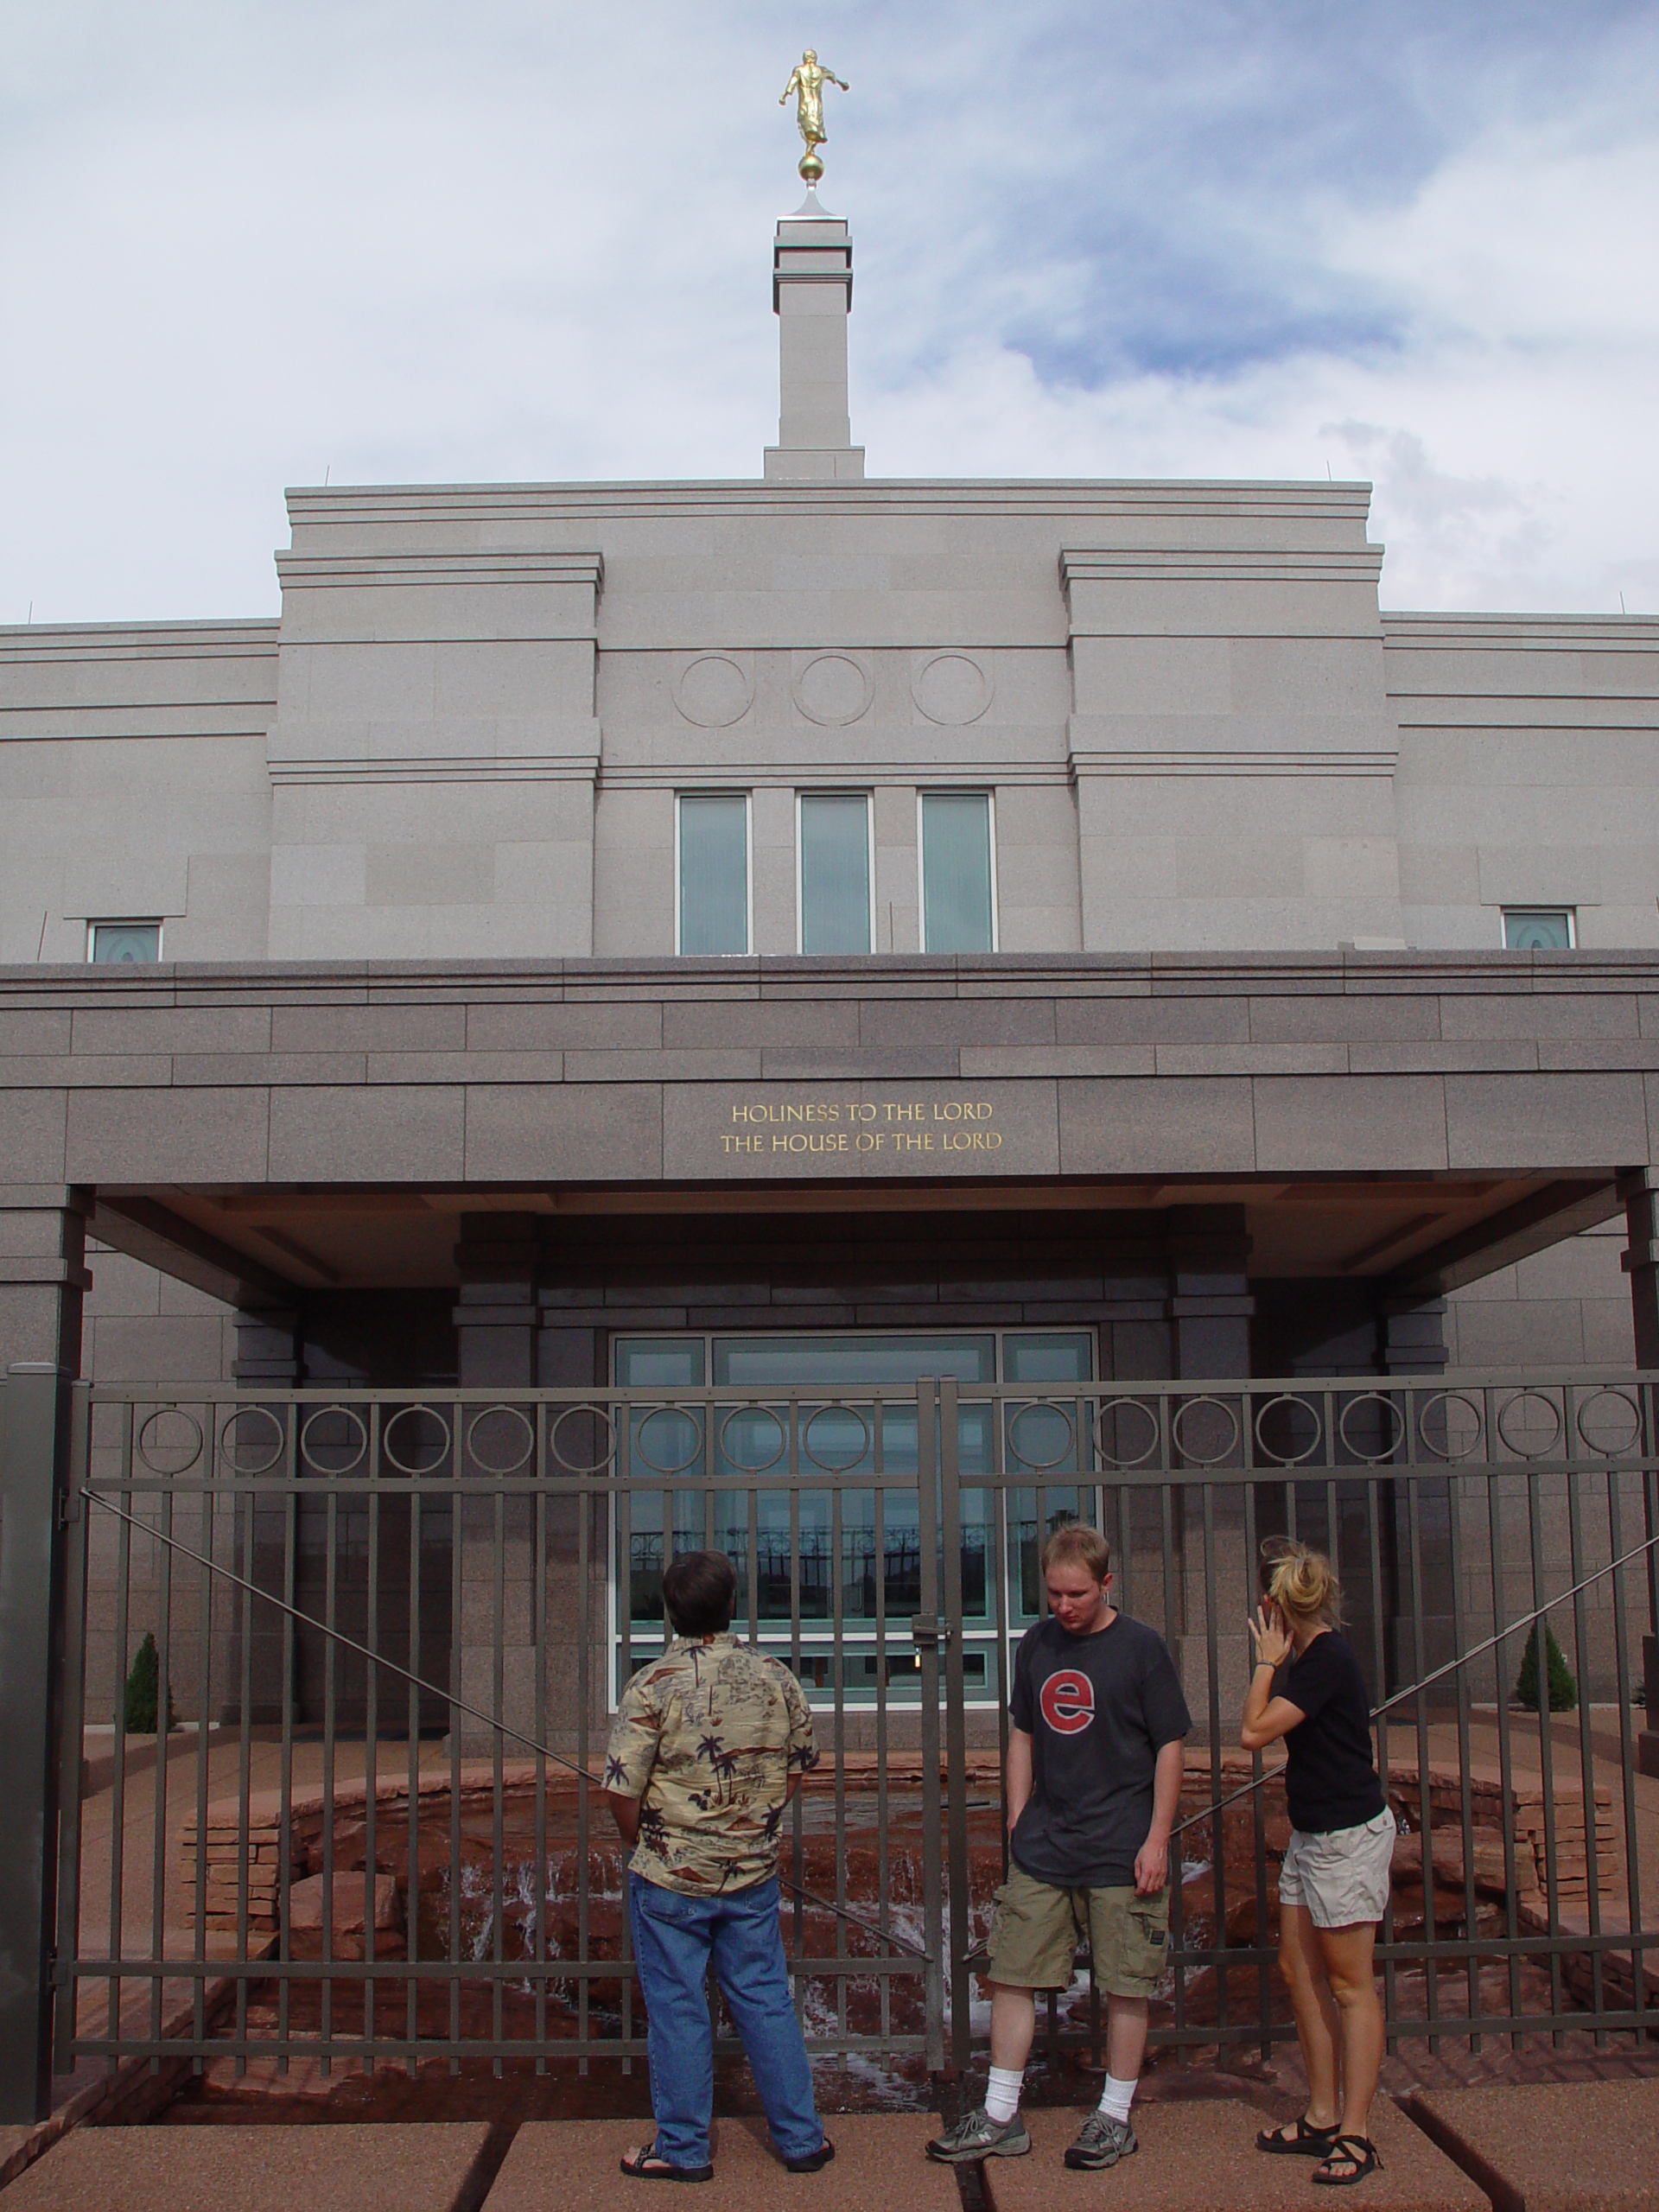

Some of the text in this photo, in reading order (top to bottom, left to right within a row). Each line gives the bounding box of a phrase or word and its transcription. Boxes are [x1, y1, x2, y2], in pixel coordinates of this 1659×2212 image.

[732, 1103, 993, 1122] HOLINESS TO THE LORD
[721, 1132, 1002, 1152] THE HOUSE OF THE LORD
[1039, 1669, 1095, 1735] e
